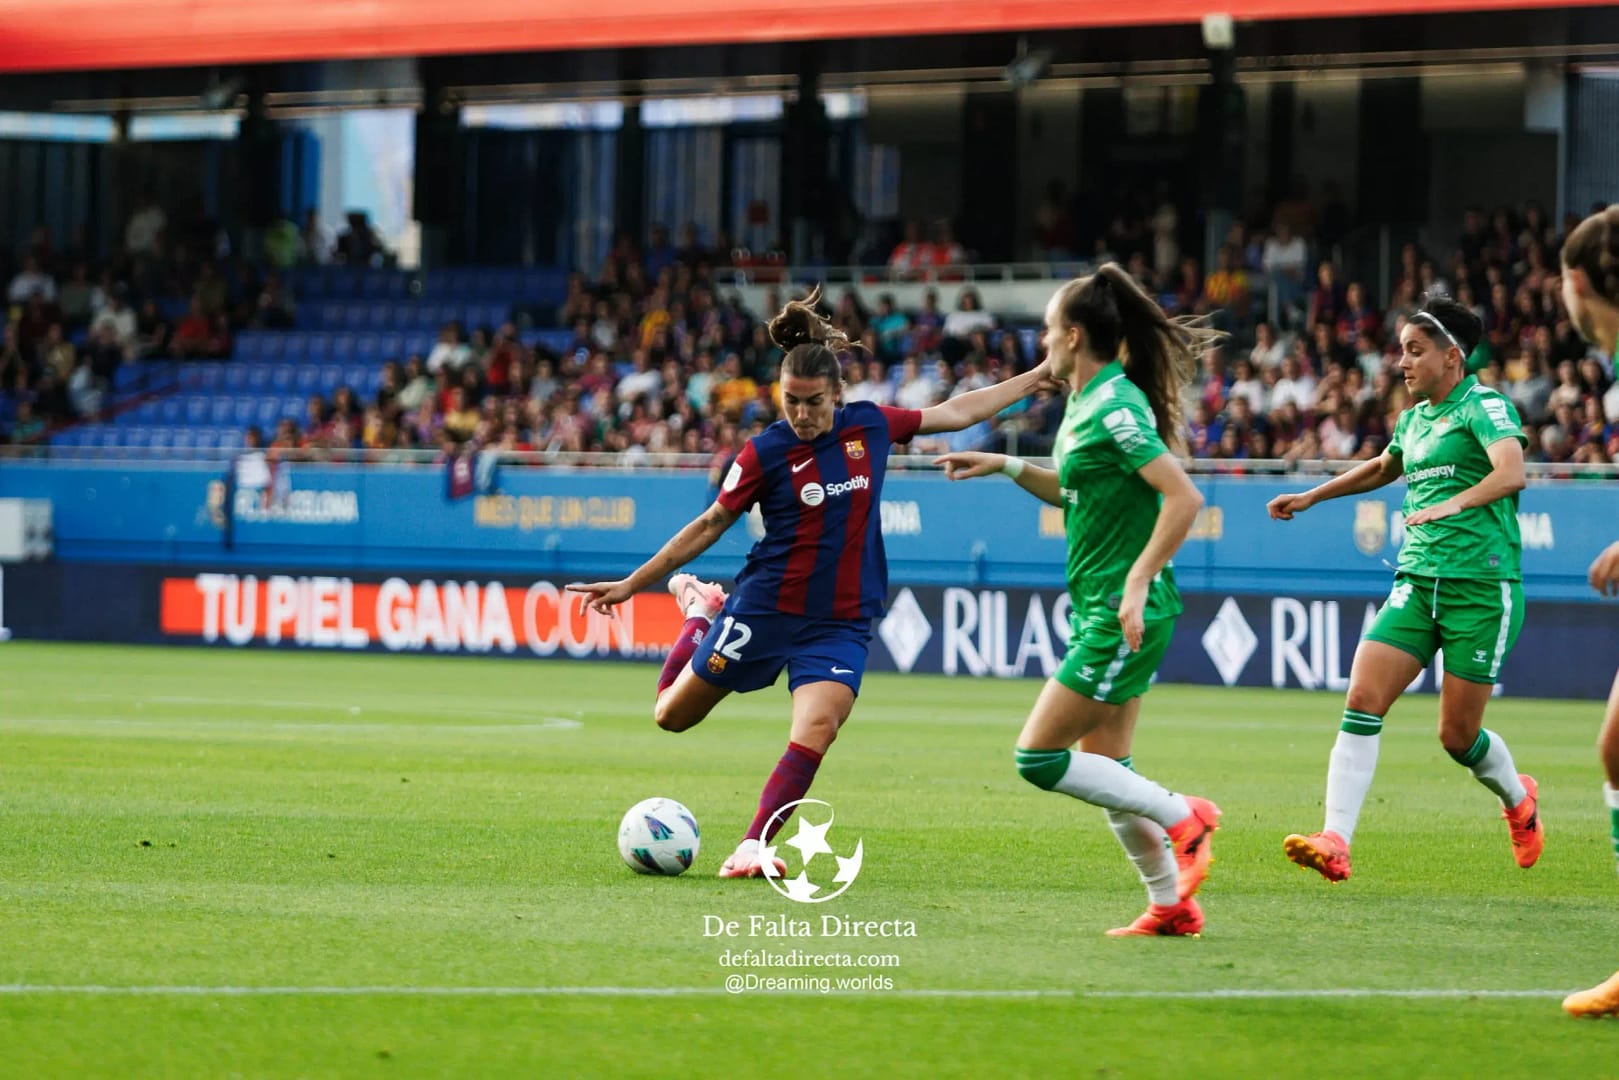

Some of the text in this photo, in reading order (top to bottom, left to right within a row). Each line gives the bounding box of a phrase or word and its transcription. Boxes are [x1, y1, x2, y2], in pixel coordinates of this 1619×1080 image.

[826, 474, 869, 496] Spotify
[196, 572, 258, 645] TU
[265, 575, 369, 648] PIEL
[375, 577, 517, 653] GANA
[713, 615, 752, 661] 12
